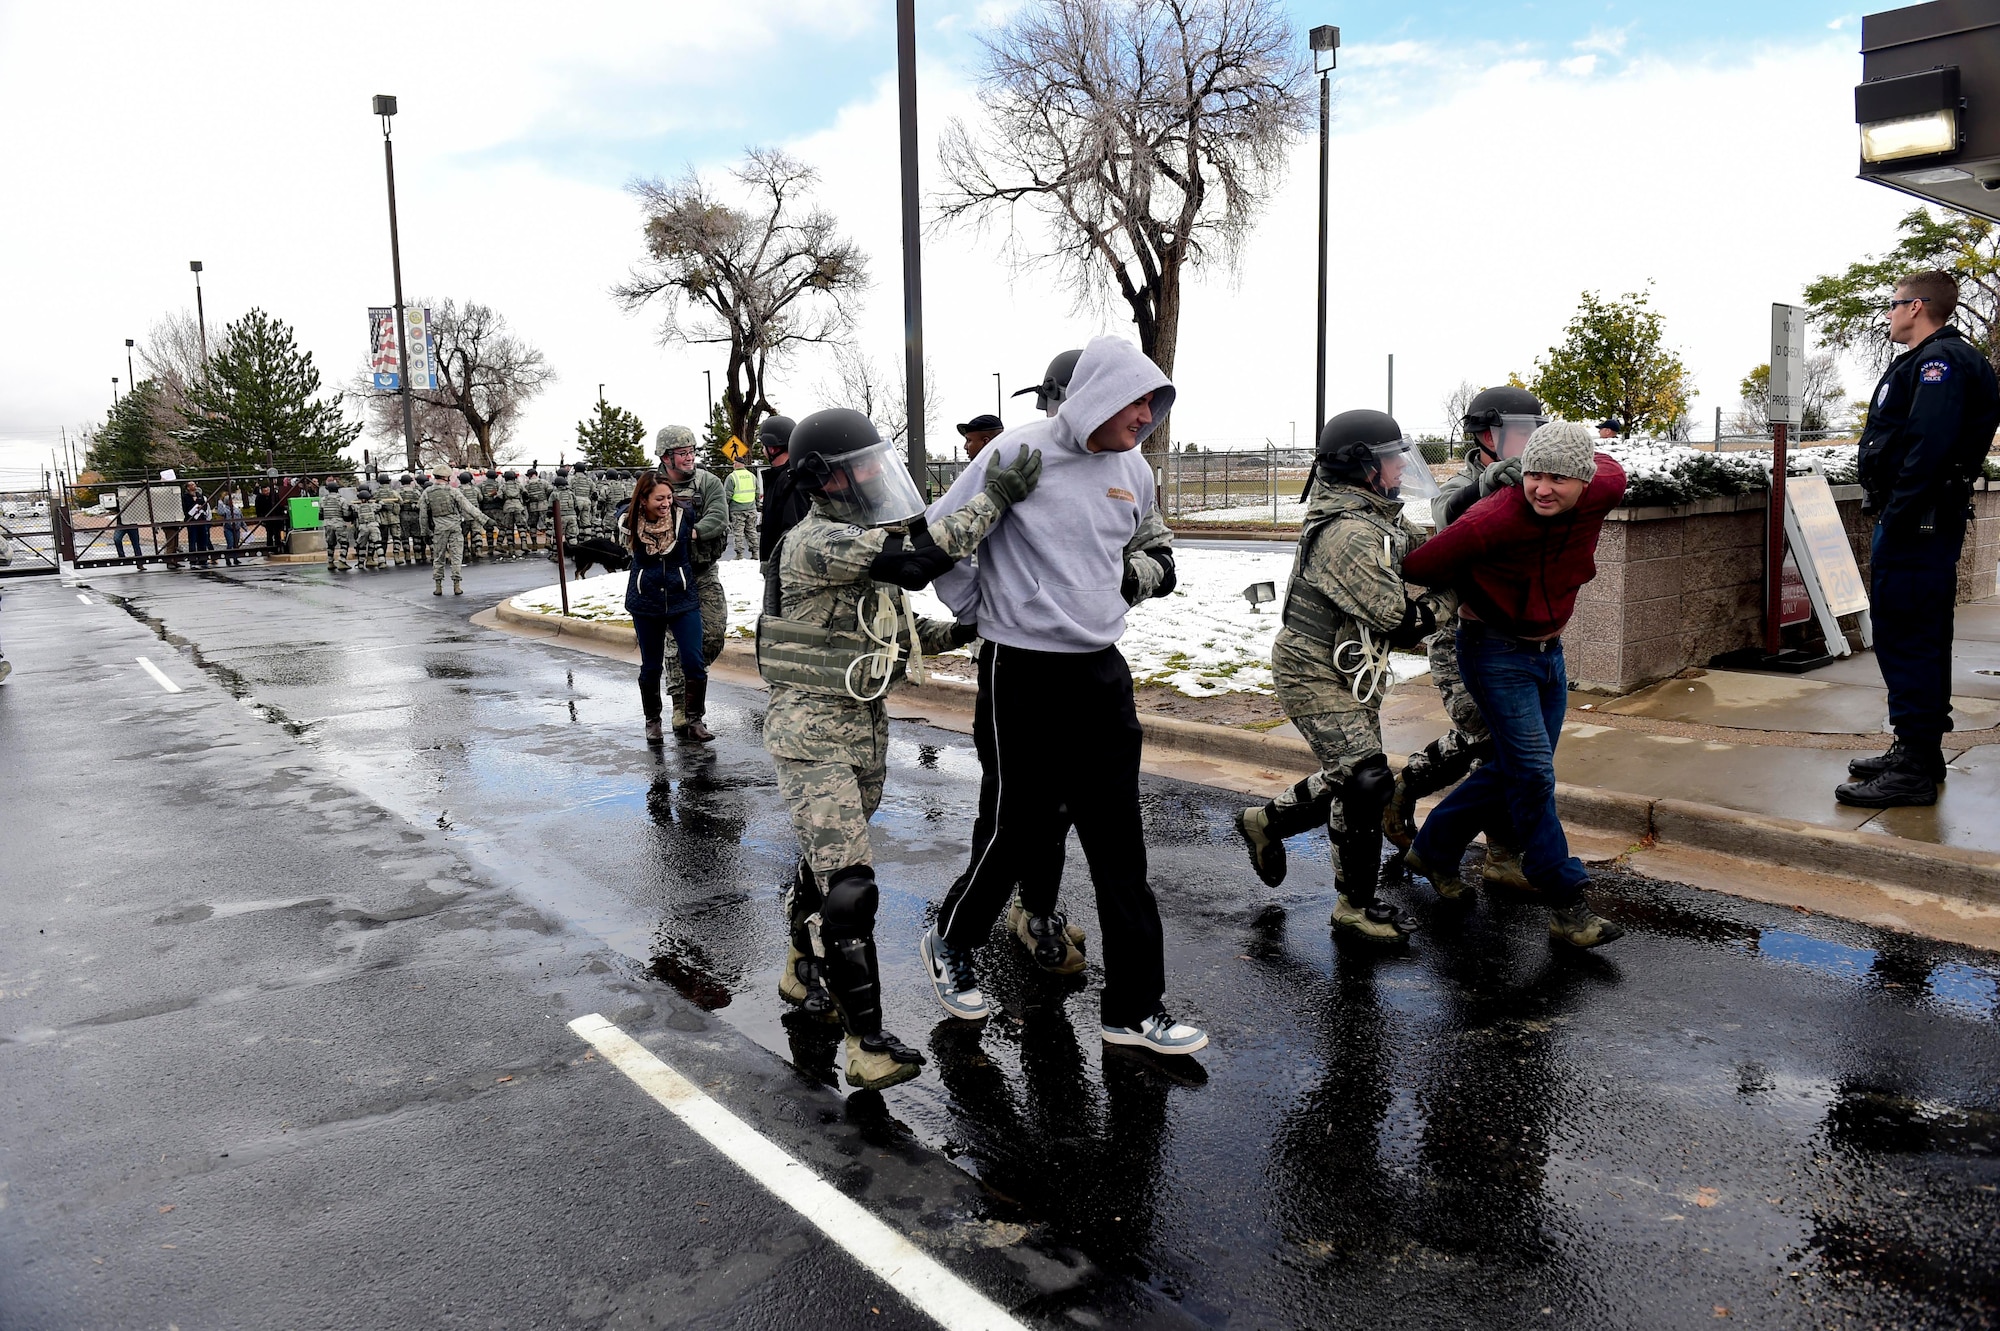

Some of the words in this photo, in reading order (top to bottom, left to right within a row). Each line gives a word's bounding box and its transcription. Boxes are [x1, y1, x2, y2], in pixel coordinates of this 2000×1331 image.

[1783, 322, 1796, 333] 100%
[1776, 345, 1781, 356] ID
[1783, 345, 1800, 358] CHECK
[1921, 361, 1947, 371] AURORA
[1785, 371, 1791, 382] IN
[1772, 394, 1800, 407] PROGRESS
[1797, 502, 1836, 518] CONDITION
[1806, 523, 1842, 541] YELLOW
[1830, 569, 1854, 598] 20
[1783, 602, 1798, 615] ONLY
